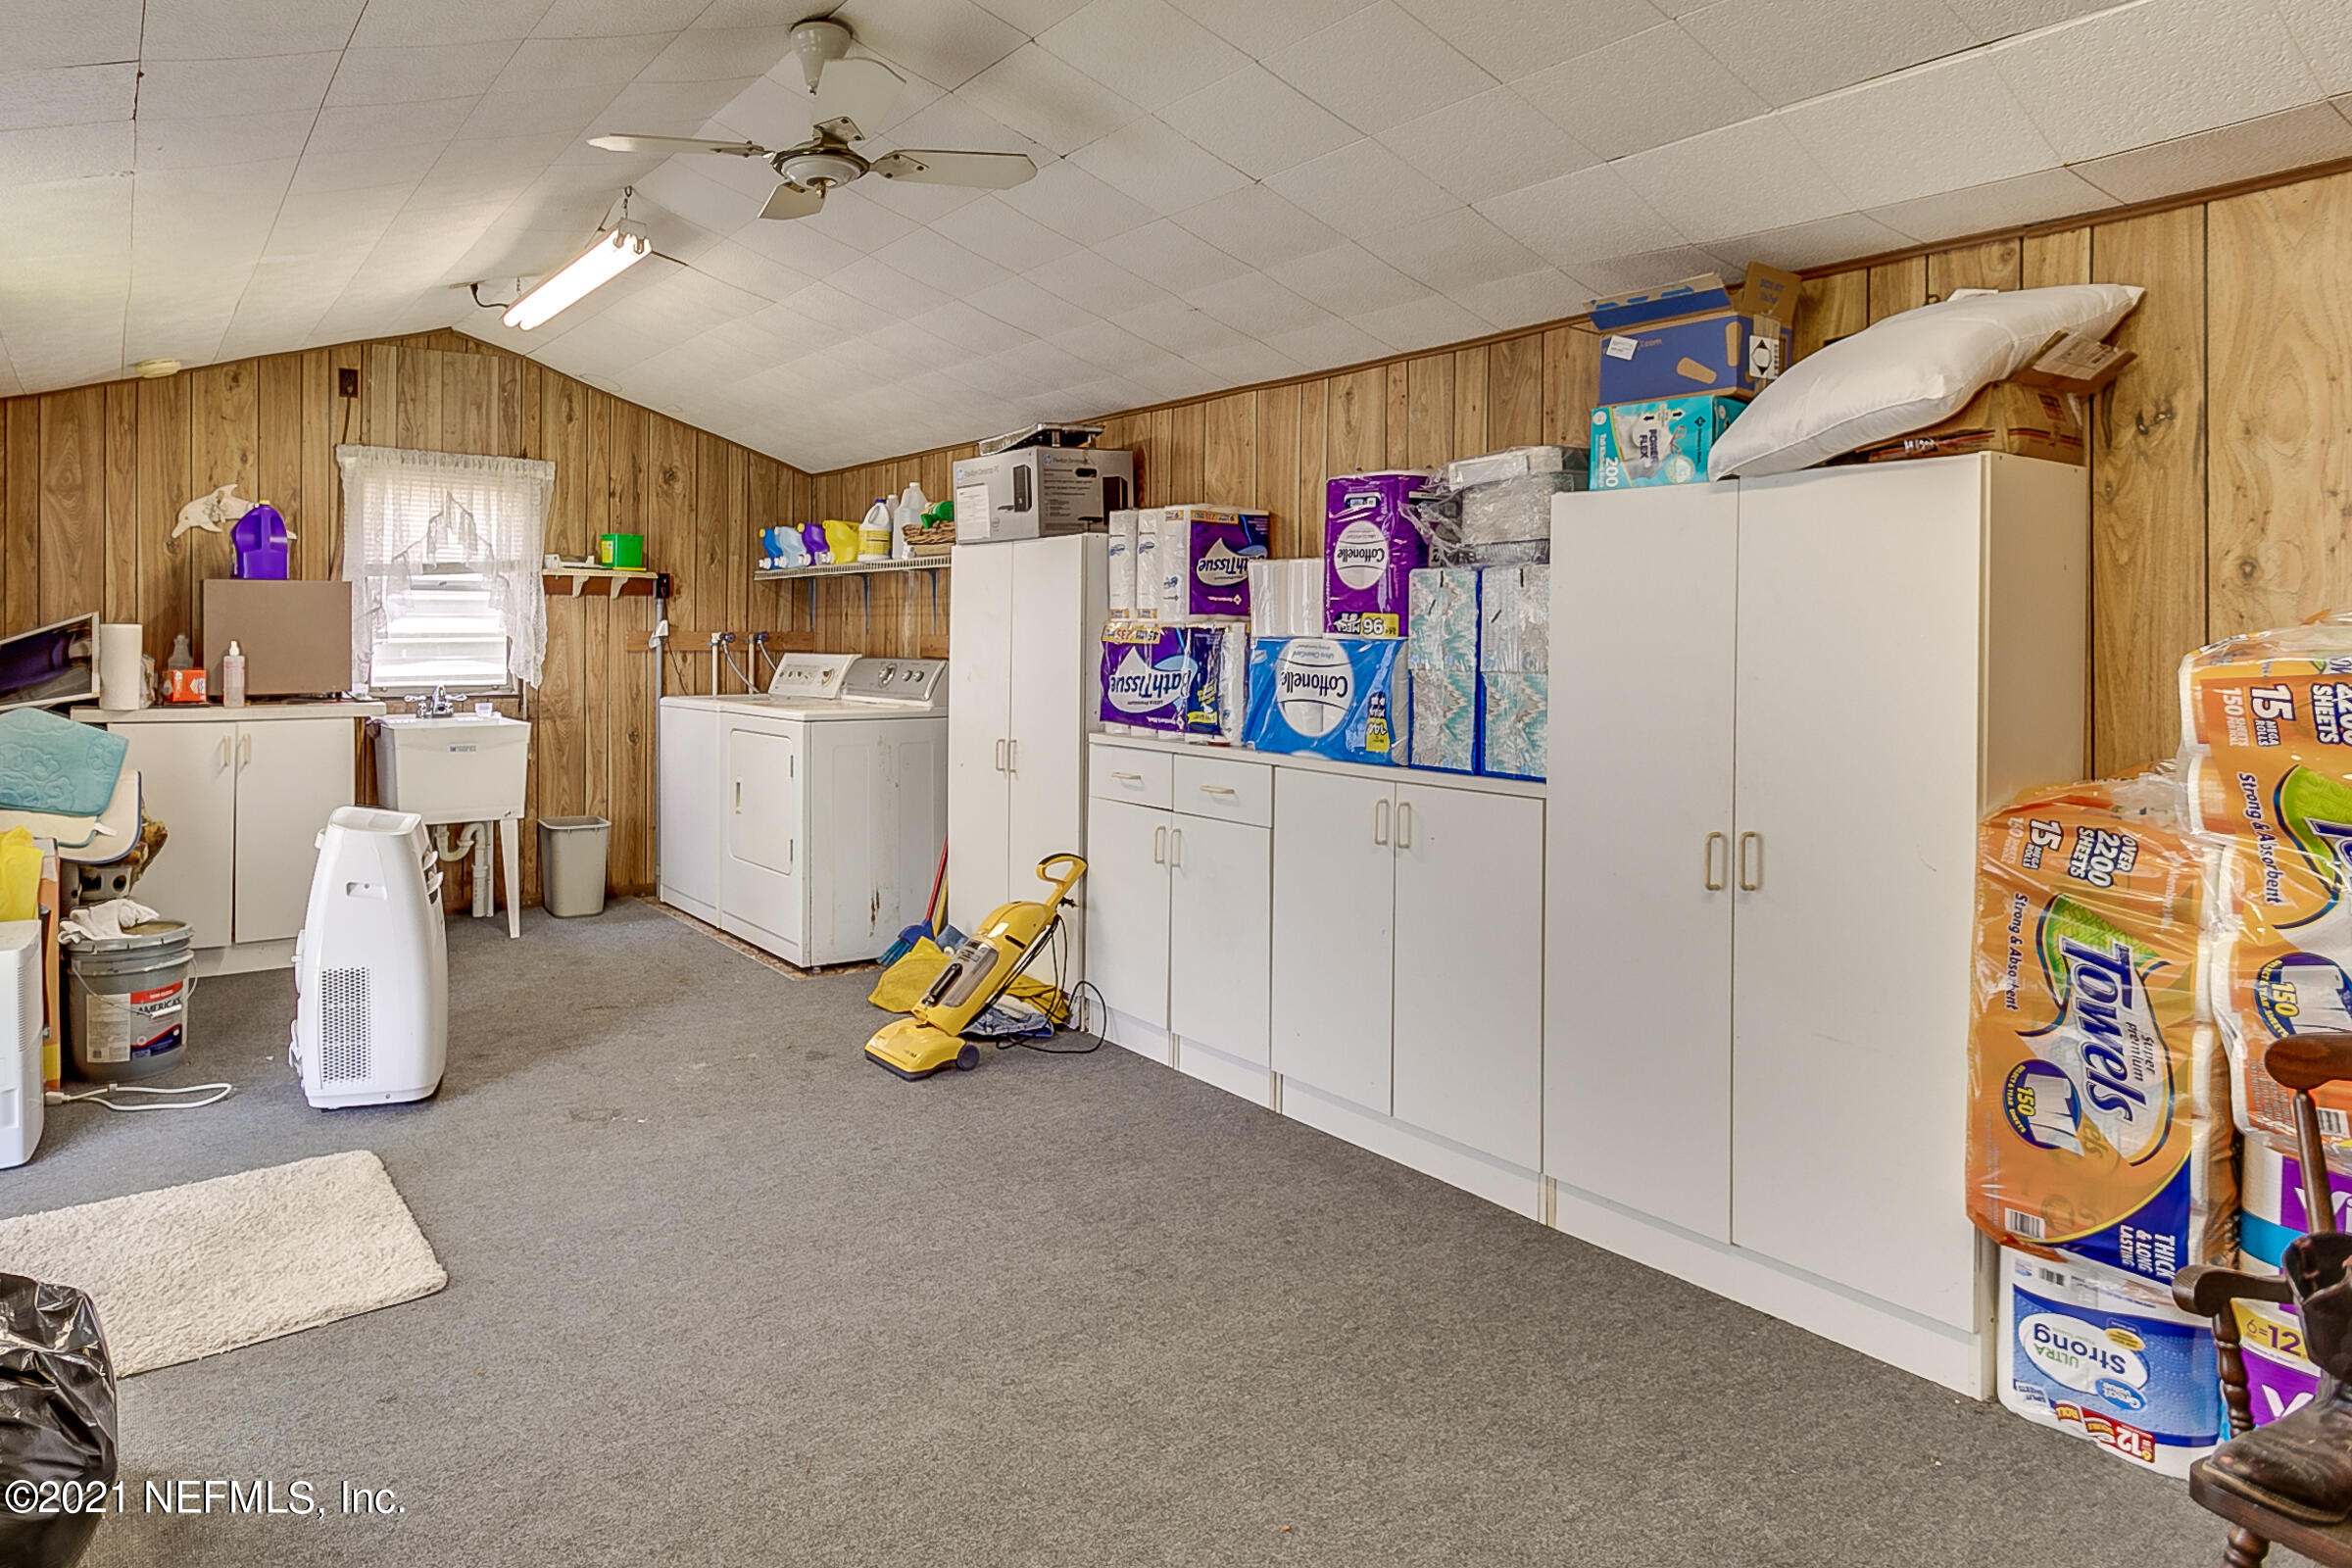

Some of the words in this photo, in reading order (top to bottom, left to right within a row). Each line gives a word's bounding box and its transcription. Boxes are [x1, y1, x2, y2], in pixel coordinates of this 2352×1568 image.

[1639, 433, 1649, 460] FLEX
[1604, 456, 1619, 488] 200
[1337, 547, 1386, 564] Cottonelle
[1361, 617, 1384, 636] 96
[1281, 671, 1348, 698] Cottonelle
[2223, 687, 2245, 716] 150
[2250, 682, 2296, 722] 15
[2311, 682, 2341, 745] SHEETS
[2254, 718, 2268, 748] ROLLS
[2266, 719, 2281, 747] MEGA
[2030, 819, 2064, 852] 15
[2237, 771, 2263, 820] Strong
[2256, 832, 2285, 906] Absorbent
[2068, 825, 2097, 880] SHEETS
[2086, 829, 2120, 889] 2200
[2117, 833, 2139, 873] OVER
[2007, 893, 2029, 939] Strong
[2009, 937, 2024, 948] &
[2270, 981, 2300, 1018] 150
[2059, 934, 2147, 1124] Towels
[2125, 1021, 2144, 1082] premium
[2016, 1087, 2036, 1117] 150
[2119, 1224, 2135, 1268] LASTING
[2135, 1229, 2153, 1241] &
[2135, 1240, 2154, 1274] LONG
[2154, 1232, 2177, 1280] THICK
[2034, 1323, 2127, 1375] Strong
[2034, 1343, 2080, 1370] ULTRA
[2116, 1423, 2143, 1454] 12
